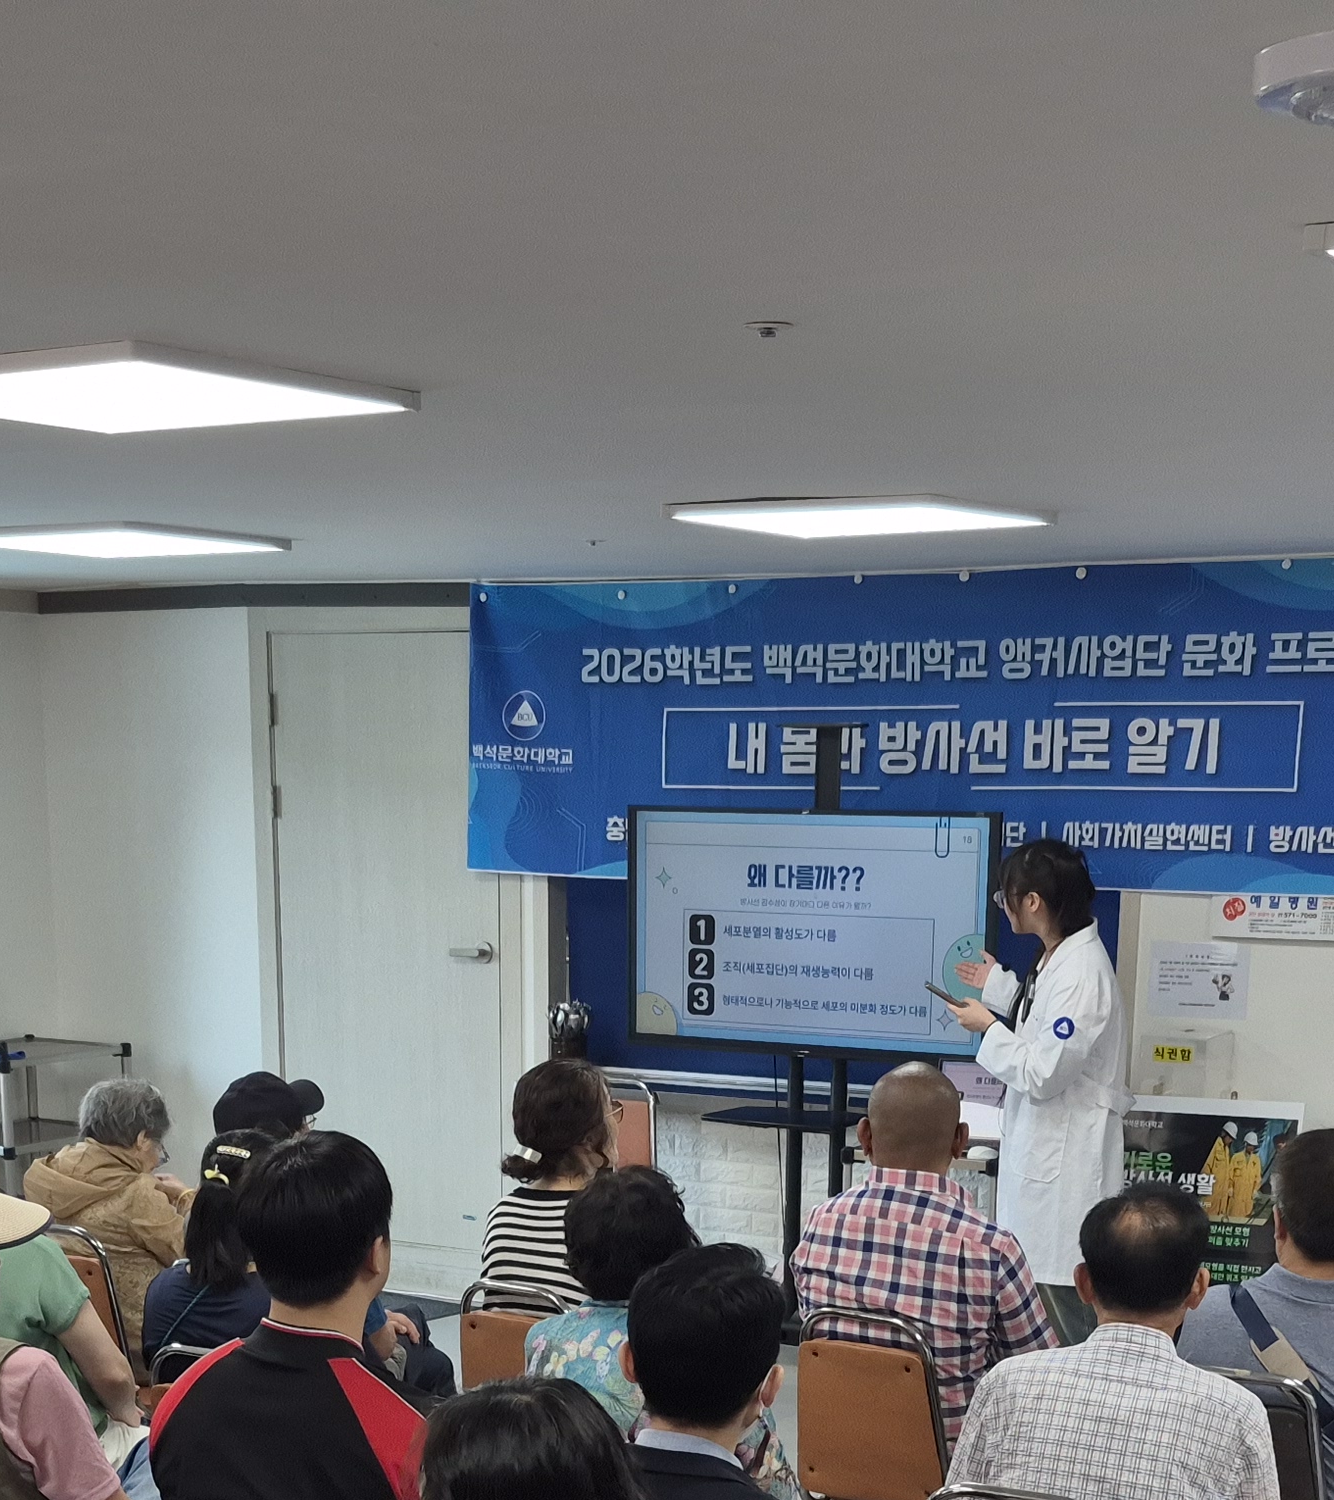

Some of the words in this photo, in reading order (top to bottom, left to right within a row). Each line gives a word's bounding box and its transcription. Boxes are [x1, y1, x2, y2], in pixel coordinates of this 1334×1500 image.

[581, 645, 754, 686] 2026학년도
[763, 639, 988, 685] 백석문화대학교
[999, 634, 1171, 680] 앵커사업단
[1182, 631, 1257, 677] 문화
[472, 744, 574, 766] 백석문화대학교
[727, 721, 766, 775] 내
[879, 720, 1007, 776] 방사선
[1023, 718, 1112, 775] 바로
[1126, 718, 1221, 775] 알기
[1062, 821, 1232, 852] 사회가치실현센터
[747, 864, 766, 888] 왜
[775, 864, 865, 892] 다를까??
[696, 919, 705, 941] 1
[723, 925, 772, 940] 세포분열의
[774, 926, 814, 941] 활성도가
[694, 953, 708, 976] 2
[722, 961, 798, 976] 조직(세포집단)의
[801, 965, 850, 980] 재생능력이
[693, 987, 709, 1011] 3
[775, 998, 818, 1011] 기능적으로
[821, 1001, 847, 1013] 세포의
[879, 1004, 906, 1018] 정도가
[1177, 1173, 1216, 1195] 생활
